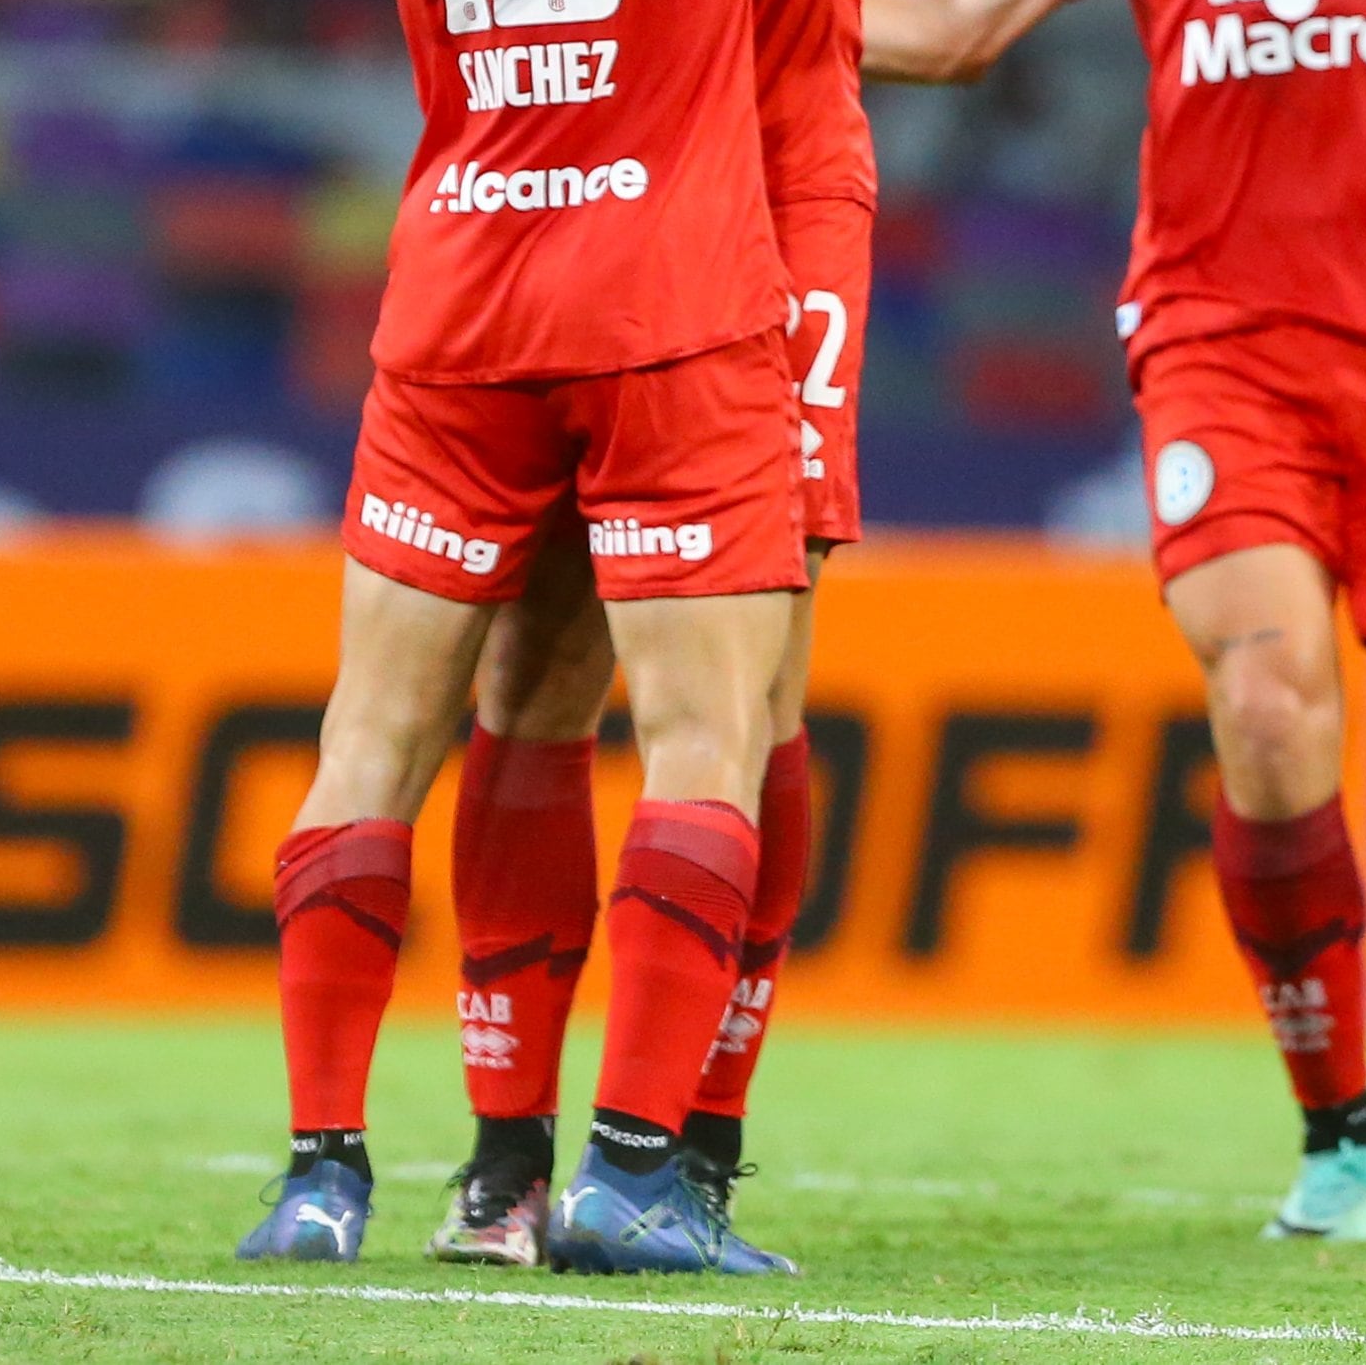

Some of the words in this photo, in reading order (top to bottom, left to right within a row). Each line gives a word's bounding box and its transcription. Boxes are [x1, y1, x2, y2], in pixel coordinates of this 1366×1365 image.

[457, 38, 620, 113] SANCHEZ
[429, 157, 649, 214] Alcance
[786, 289, 849, 410] 2
[360, 493, 501, 575] Riiing
[588, 518, 713, 562] Riiing
[456, 990, 514, 1025] CAB
[730, 977, 774, 1011] AB
